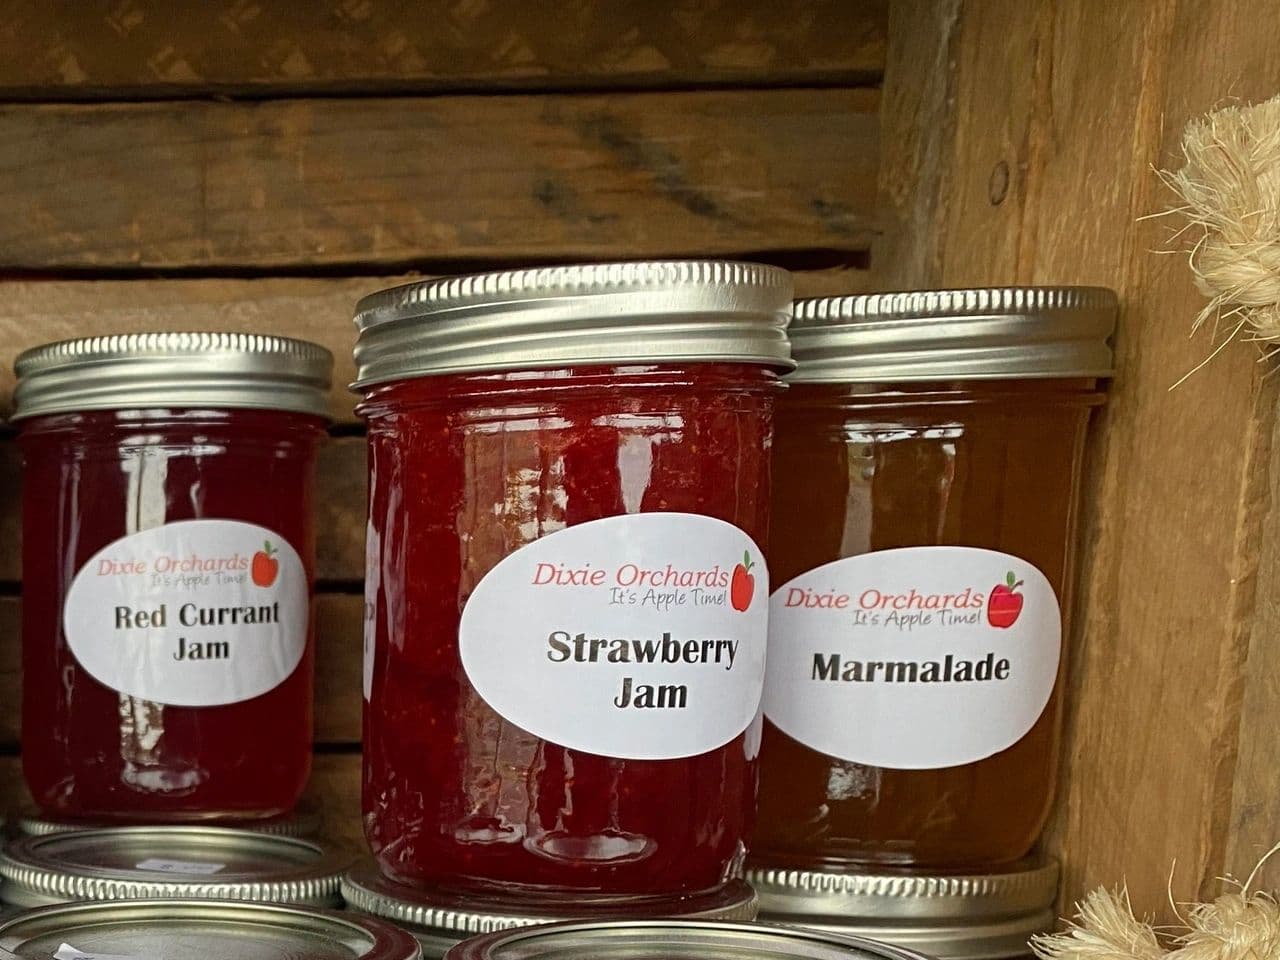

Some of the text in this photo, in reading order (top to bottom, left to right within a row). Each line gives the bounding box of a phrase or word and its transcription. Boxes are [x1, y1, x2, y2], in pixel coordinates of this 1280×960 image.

[97, 553, 249, 576] Dixie Orchards
[531, 563, 729, 587] Dixie Orchards
[609, 587, 727, 611] It's Apple Time!
[784, 587, 984, 611] Dixie Orchards
[115, 601, 280, 629] Red Currant
[853, 609, 981, 631] It's Apple Time!
[173, 637, 230, 661] Jam
[547, 630, 739, 670] Strawberry
[812, 652, 1010, 683] Marmalade
[613, 677, 688, 709] Jam
